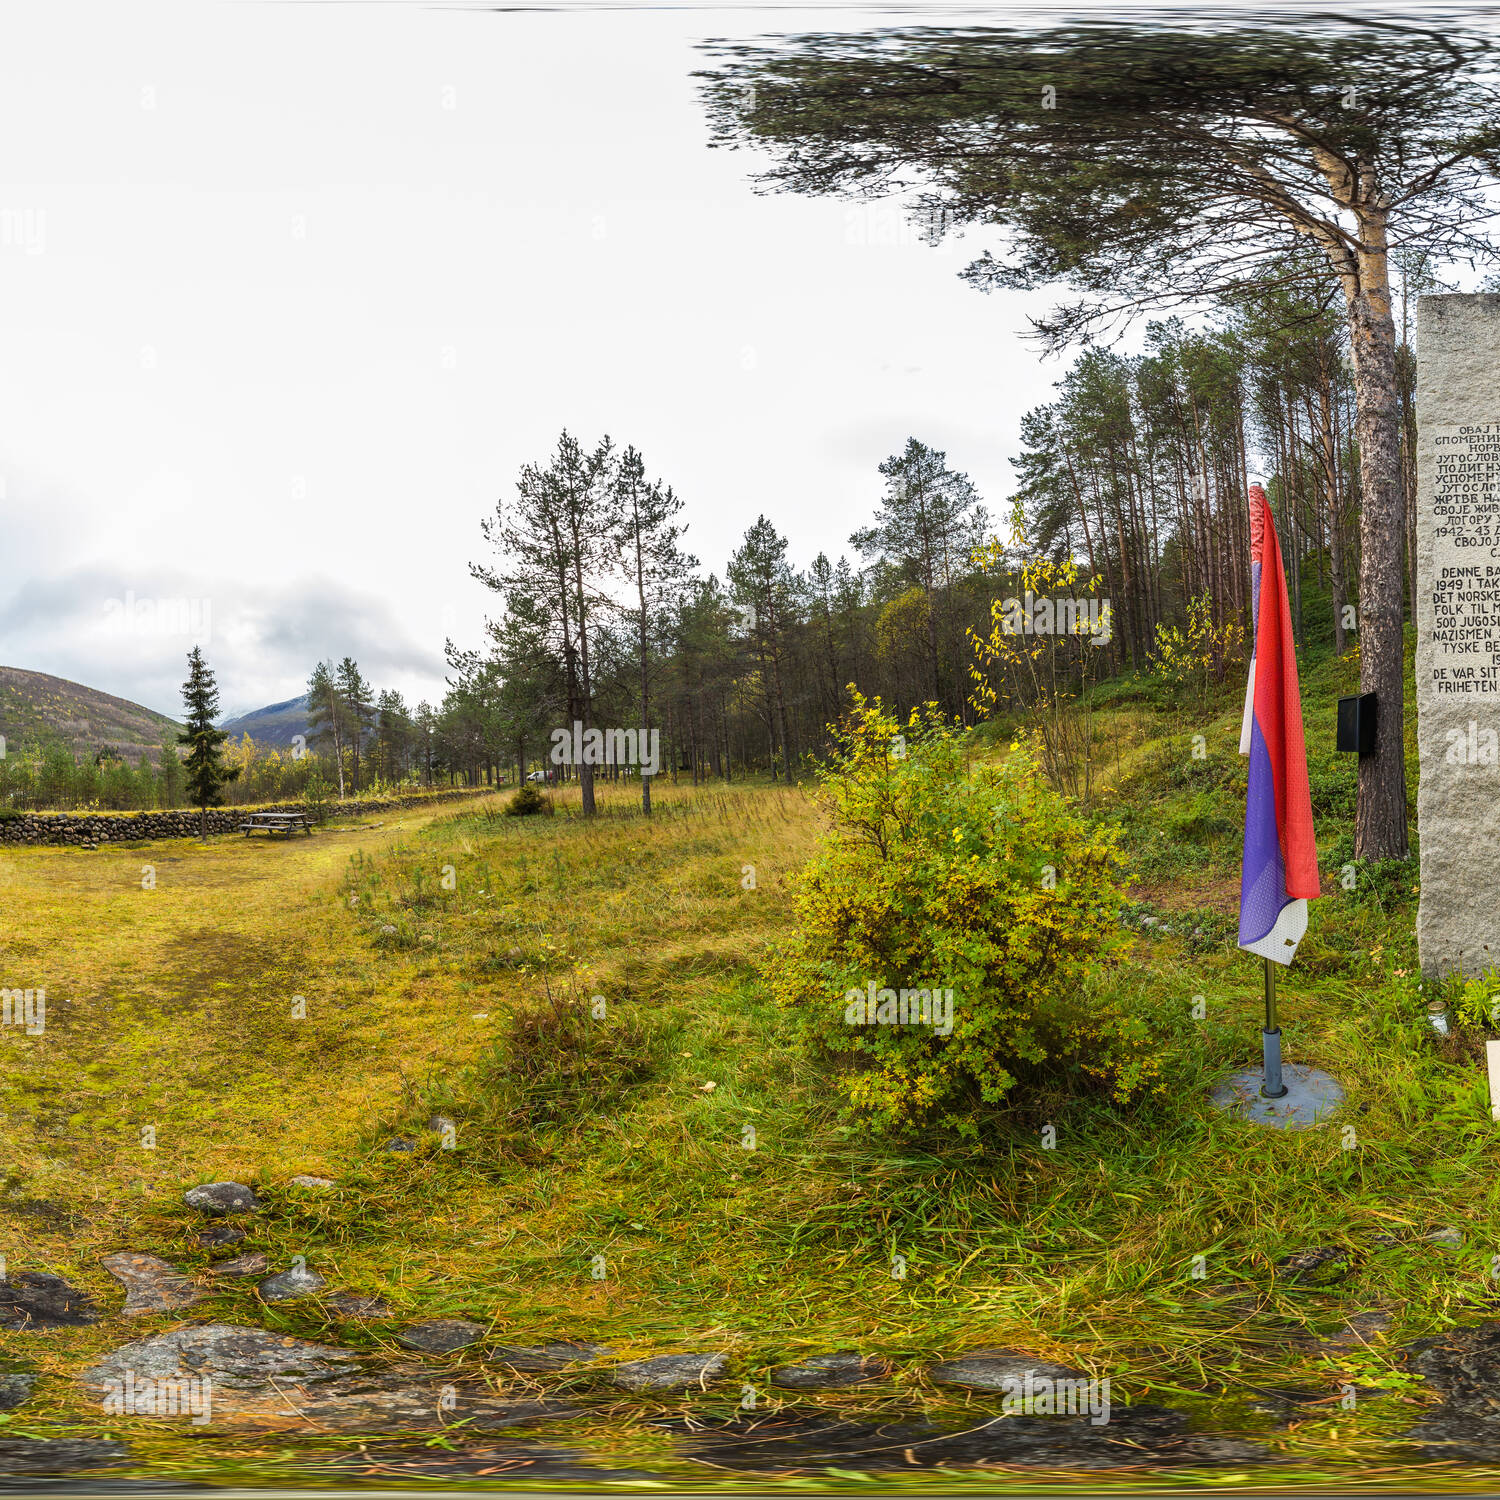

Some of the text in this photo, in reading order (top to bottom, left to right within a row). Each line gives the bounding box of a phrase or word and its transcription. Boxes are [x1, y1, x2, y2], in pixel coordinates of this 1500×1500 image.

[1460, 425, 1490, 434] ОВАЈ
[1434, 494, 1478, 504] ЖРТВЕ
[1433, 505, 1471, 515] СВОЈЕ
[1445, 515, 1492, 525] ЛОГОРУ
[1454, 537, 1500, 547] СВОЈОЈ
[1442, 567, 1481, 578] DENNE
[1436, 579, 1463, 590] 1949
[1468, 579, 1471, 589] I
[1433, 592, 1453, 604] DET
[1458, 590, 1500, 602] NORSKE
[1434, 604, 1463, 615] FOLK
[1471, 603, 1489, 614] TIL
[1437, 617, 1456, 628] 500
[1433, 628, 1491, 641] NAZISMEN
[1442, 641, 1479, 653] TYSKE
[1433, 668, 1447, 679] DE
[1452, 667, 1475, 679] VAR
[1438, 680, 1497, 693] FRIHETEN
